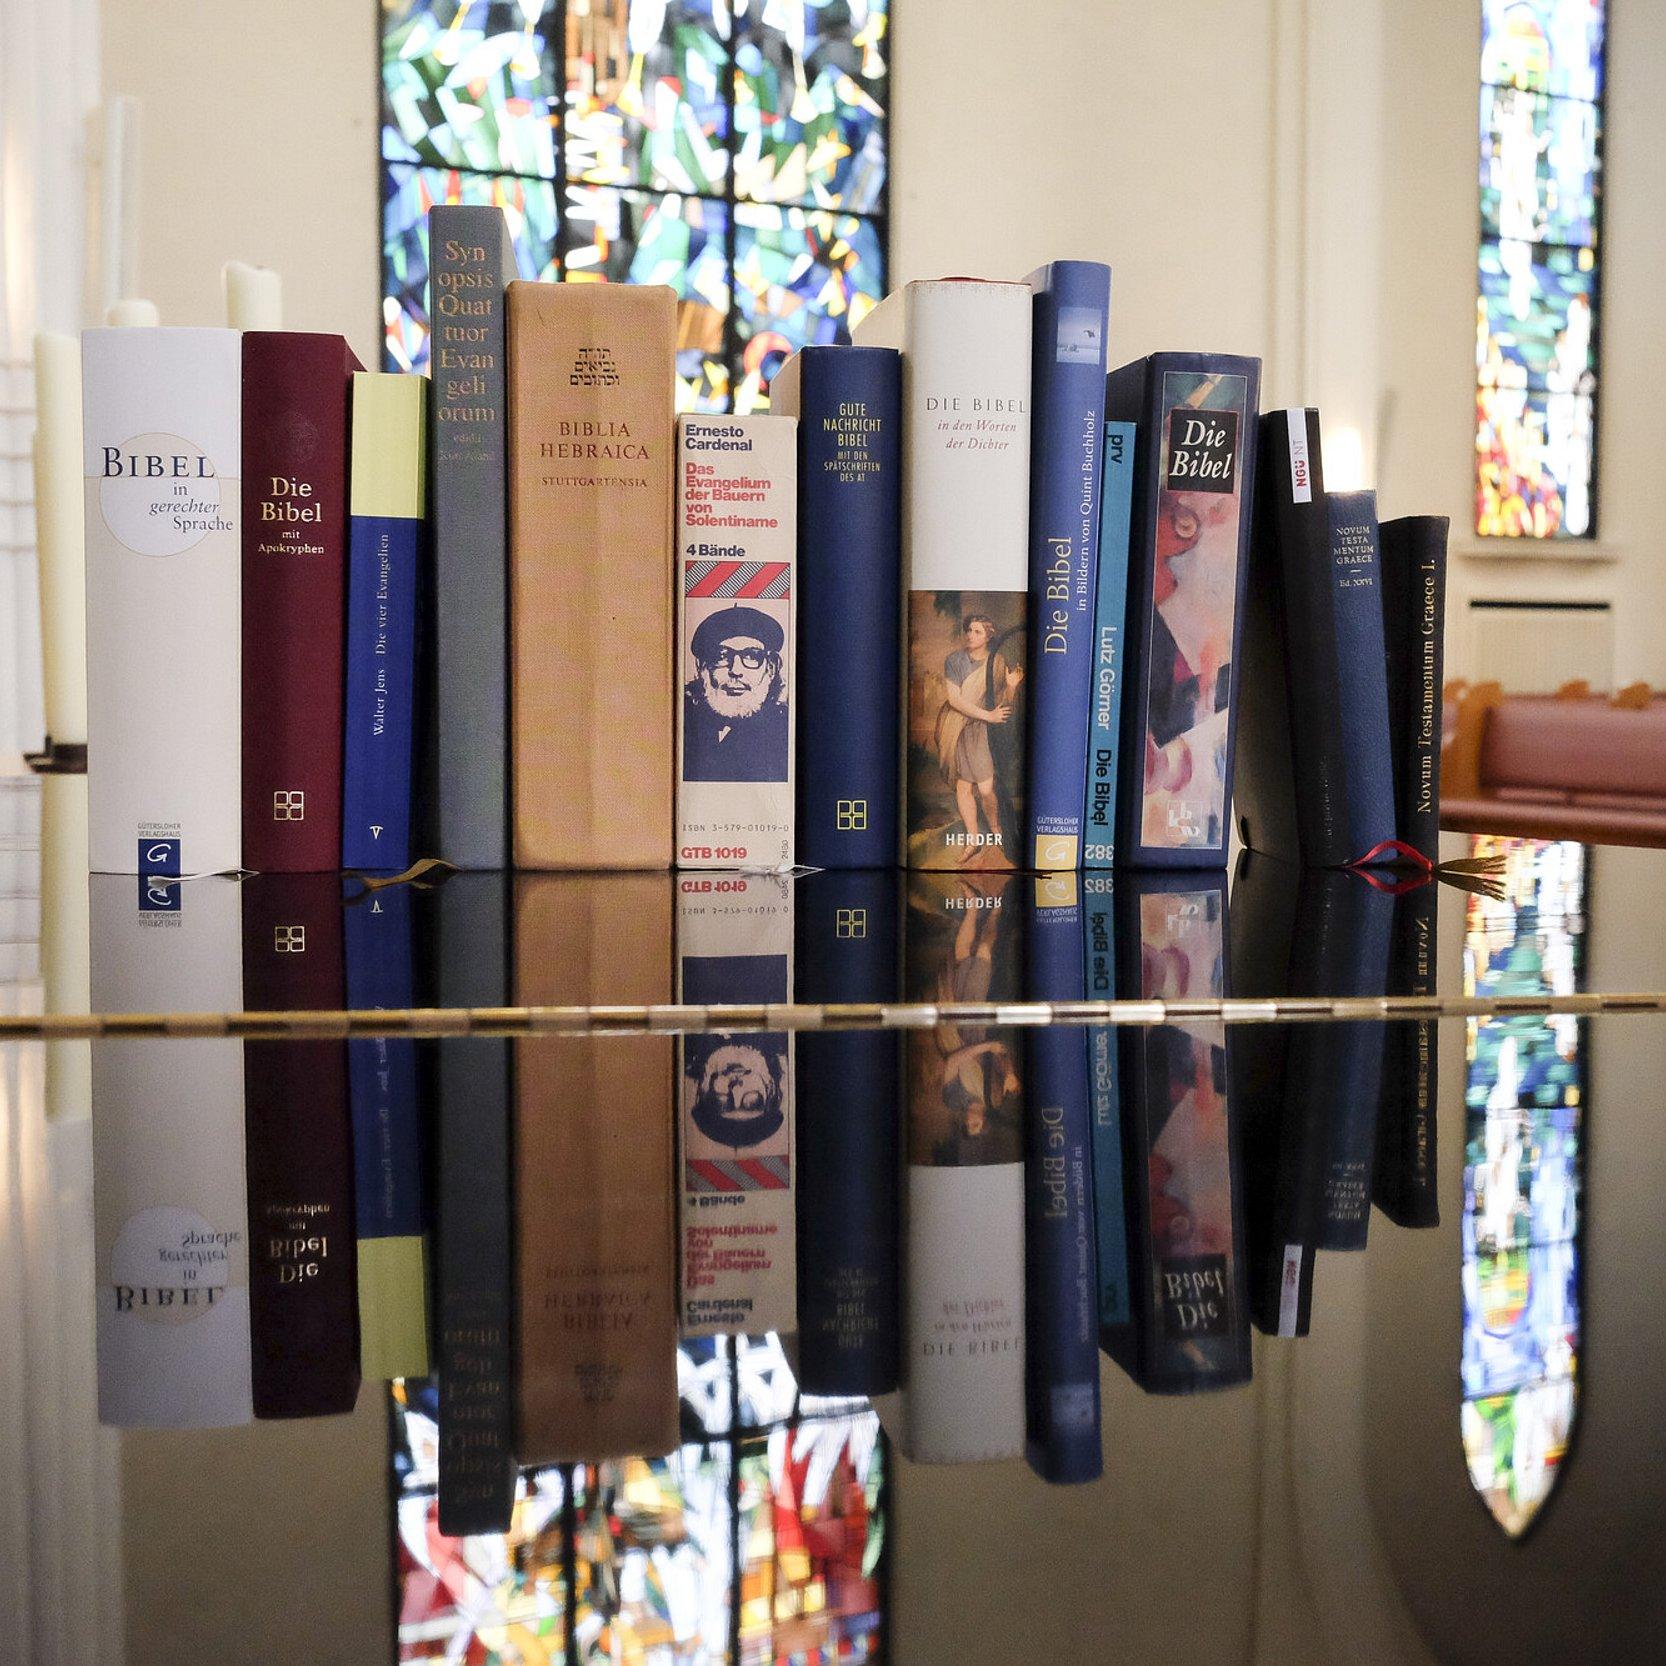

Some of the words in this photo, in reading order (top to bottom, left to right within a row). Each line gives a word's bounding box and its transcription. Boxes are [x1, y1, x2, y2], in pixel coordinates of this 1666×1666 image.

[445, 240, 485, 265] Syn
[439, 268, 494, 293] opsis
[439, 294, 492, 317] Quat
[444, 327, 488, 342] tuor
[441, 350, 494, 369] Evan
[447, 375, 485, 400] geli
[438, 406, 495, 421] orum
[839, 403, 866, 416] GUTE
[926, 398, 961, 411] DIE
[973, 398, 1026, 413] BIBEL
[560, 422, 630, 437] BIBLIA
[685, 424, 744, 437] Ernesto
[823, 418, 882, 432] NACHRICHT
[937, 420, 949, 431] in
[952, 420, 972, 431] den
[976, 420, 1017, 432] Worten
[837, 434, 868, 447] BIBEL
[1081, 410, 1096, 472] Buchholz
[1181, 420, 1226, 447] Die
[540, 443, 649, 460] HEBRAICA
[685, 438, 752, 451] Cardenal
[946, 438, 964, 449] der
[967, 437, 1009, 450] Dichter
[1107, 434, 1124, 464] prv
[1292, 439, 1304, 455] NT
[837, 451, 850, 460] MIT
[853, 451, 868, 460] DEN
[685, 462, 715, 475] Das
[824, 460, 880, 472] SPÄTSCHRIFTEN
[1169, 451, 1232, 479] Bibel
[542, 476, 648, 488] STUTTGARTENSIA
[685, 476, 771, 490] Evangelium
[840, 472, 854, 482] DES
[857, 472, 865, 482] AT
[173, 482, 188, 496] in
[271, 477, 312, 497] Die
[685, 489, 710, 501] der
[712, 489, 765, 501] Bauern
[1080, 476, 1094, 515] Quint
[149, 499, 220, 516] gerechter
[260, 502, 322, 523] Bibel
[685, 503, 712, 514] von
[173, 515, 234, 533] Sprache
[685, 514, 778, 528] Solentiname
[282, 529, 300, 539] mit
[1080, 518, 1091, 544] von
[1336, 526, 1370, 535] NOVUM
[1342, 536, 1368, 544] TESTA
[258, 542, 325, 555] Apokryphen
[686, 544, 696, 556] 4
[699, 544, 746, 557] Bände
[1333, 545, 1374, 555] MENTUM
[377, 534, 391, 599] Evangelien
[1336, 555, 1373, 565] GRAECE
[1046, 537, 1072, 602] Bibel
[1077, 547, 1089, 596] Bildern
[1076, 598, 1087, 611] in
[1422, 577, 1435, 635] Graece
[377, 604, 388, 627] vier
[1044, 610, 1069, 655] Die
[375, 633, 387, 655] Die
[1100, 626, 1117, 664] Lutz
[375, 668, 388, 694] Jens
[1098, 671, 1115, 731] Görner
[1418, 641, 1434, 748] Testamentum
[373, 697, 386, 736] Walter
[1095, 749, 1112, 778] Die
[1417, 755, 1432, 813] Novum
[1090, 785, 1110, 826] Bibel
[682, 824, 705, 832] ISBN
[712, 824, 789, 832] 3-579-01019-0
[946, 833, 1003, 846] HERDER
[681, 847, 712, 859] GTB
[715, 847, 747, 859] 1019
[1085, 844, 1114, 861] 382
